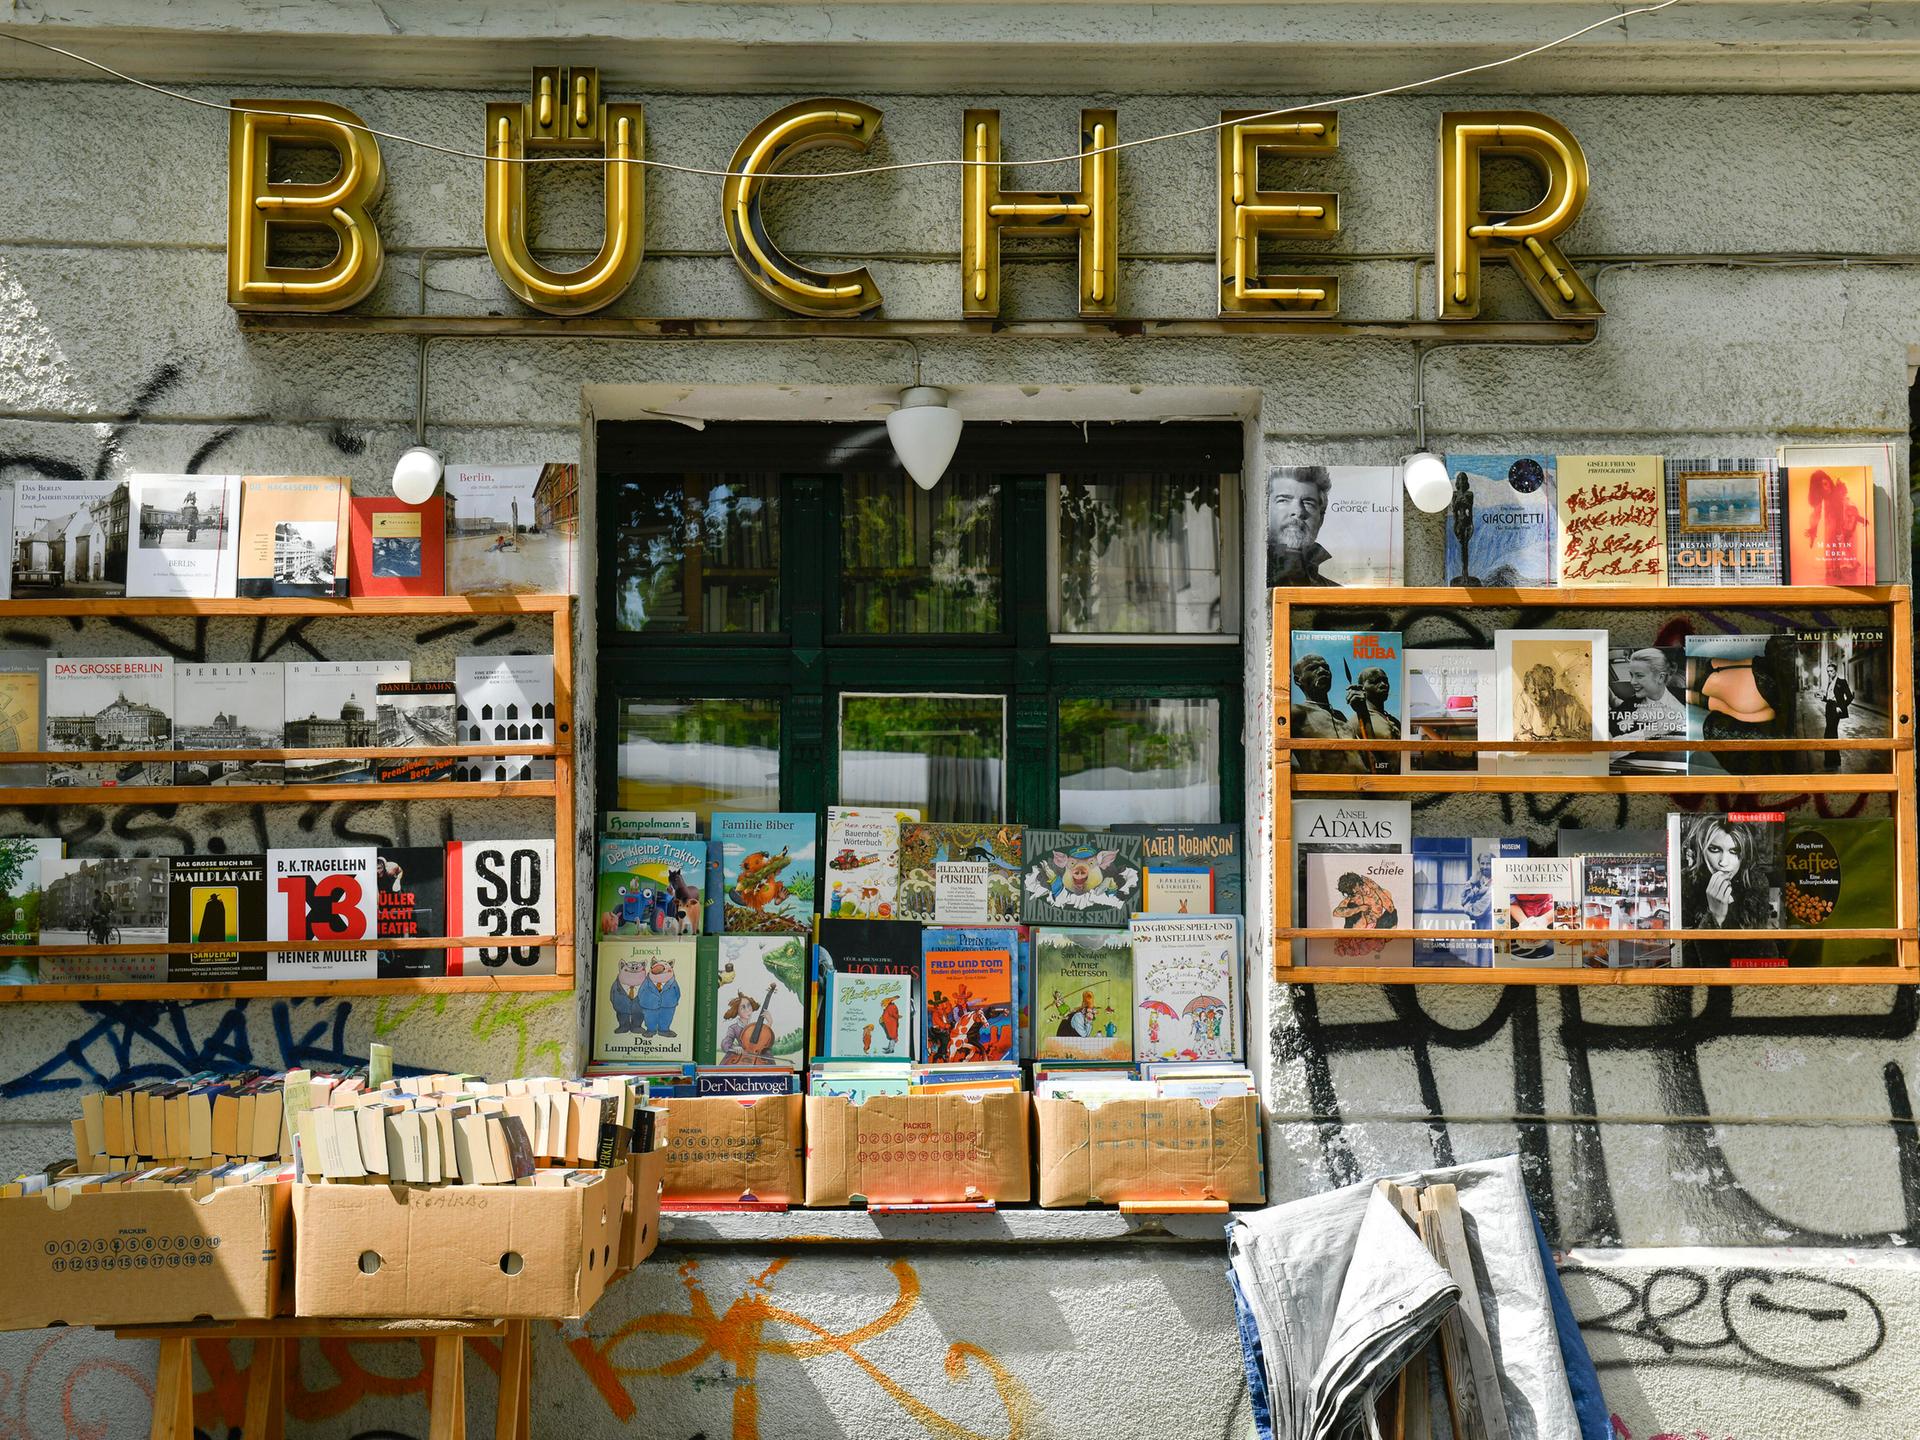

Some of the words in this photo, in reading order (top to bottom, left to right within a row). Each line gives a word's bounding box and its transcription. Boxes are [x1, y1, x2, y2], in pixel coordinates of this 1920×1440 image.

[228, 66, 1606, 319] BÜCHER
[459, 473, 495, 482] Berlin,
[1331, 503, 1368, 514] George
[1372, 503, 1400, 513] Lucas
[1482, 513, 1544, 524] GIACOMETTI
[1677, 549, 1774, 567] GURLITT
[168, 560, 196, 568] BERLIN
[1353, 635, 1379, 647] DIE
[1797, 632, 1828, 641] LMUT
[1353, 647, 1396, 659] NUBA
[55, 664, 77, 674] DAS
[79, 664, 122, 674] GROSSE
[124, 663, 163, 673] BERLIN
[186, 666, 257, 677] BERLIN
[380, 683, 422, 692] DANIELA
[1609, 711, 1639, 720] TARS
[1642, 711, 1665, 720] AND
[1667, 711, 1686, 720] CA
[1619, 722, 1634, 732] OF
[1636, 722, 1658, 731] THE
[1336, 808, 1368, 819] ANSEL
[611, 817, 690, 831] Hampelmann's
[722, 819, 763, 830] Familie
[766, 819, 795, 830] Biber
[1308, 815, 1392, 838] ADAMS
[844, 830, 882, 838] Bauernhof-
[843, 837, 883, 847] Wörterbuch
[1142, 834, 1176, 857] KATER
[1178, 834, 1233, 858] ROBINSON
[607, 850, 626, 865] Der
[629, 844, 660, 857] kleine
[663, 843, 702, 868] Traktor
[1505, 863, 1569, 873] BROOKLYN
[1785, 852, 1838, 874] Kaffee
[937, 865, 988, 874] ALEXANDER
[1366, 866, 1404, 875] Schiele
[169, 871, 263, 883] EMAILPLAKATE
[475, 849, 541, 907] SO
[940, 874, 983, 885] PUSHKIN
[1513, 874, 1563, 883] MAKERS
[378, 890, 416, 906] ÜLLER
[377, 908, 413, 920] ACHT
[1023, 898, 1085, 924] MAURICE
[377, 921, 418, 935] EATER
[1133, 924, 1151, 933] DAS
[1151, 923, 1185, 932] GROSSE
[1, 930, 32, 941] schön
[478, 907, 541, 967] 36
[1155, 934, 1212, 943] BASTELHAUS
[278, 950, 320, 963] HEINER
[631, 946, 662, 957] Janosch
[931, 960, 956, 968] FRED
[1070, 960, 1098, 969] Armer
[1060, 968, 1108, 977] Pettersson
[634, 1037, 652, 1046] Das
[605, 1043, 682, 1055] Lumpengesindel
[700, 1078, 723, 1092] Der
[724, 1077, 788, 1094] Nachtvogel
[599, 1137, 614, 1169] VERKILL
